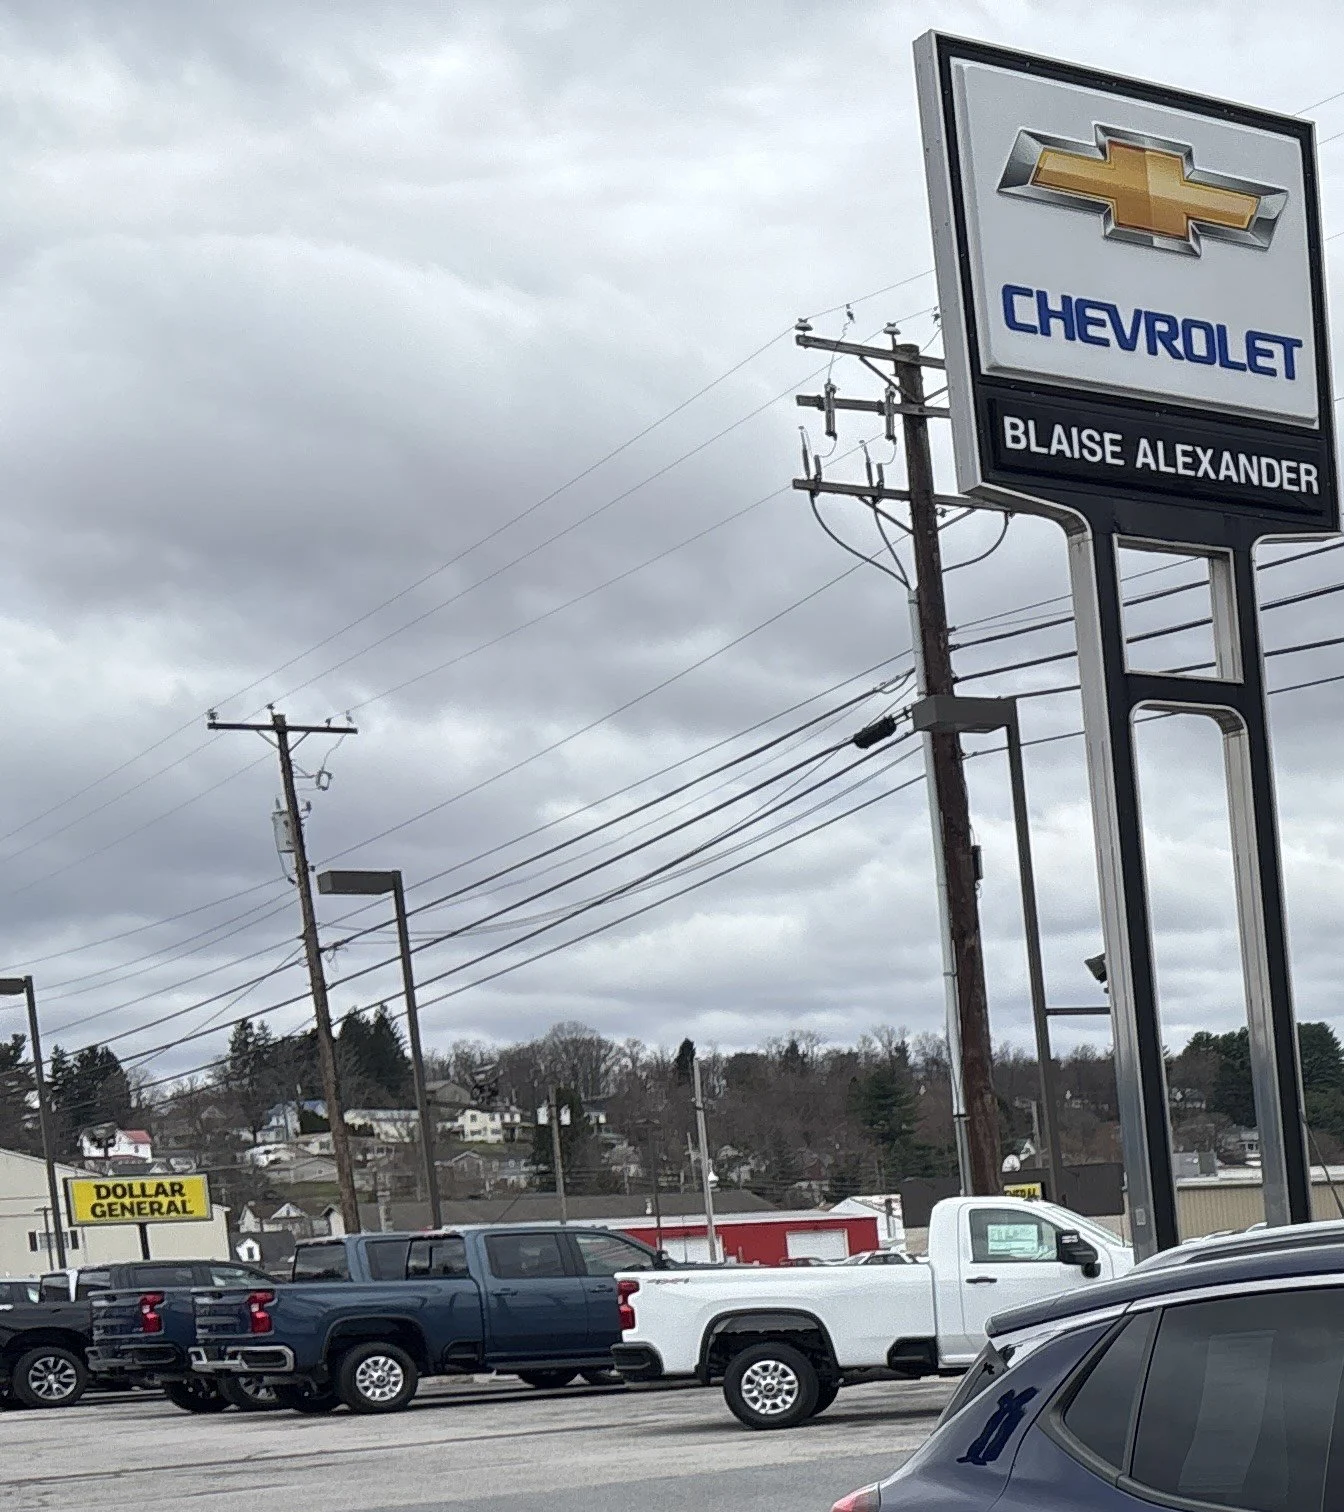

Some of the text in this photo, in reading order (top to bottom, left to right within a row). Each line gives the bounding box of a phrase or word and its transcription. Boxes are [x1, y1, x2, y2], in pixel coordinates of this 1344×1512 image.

[1001, 283, 1303, 381] CHEVROLET
[1003, 415, 1320, 495] BLAISE ALEXANDER
[90, 1199, 195, 1218] GENERAL
[93, 1181, 186, 1200] DOLLAR
